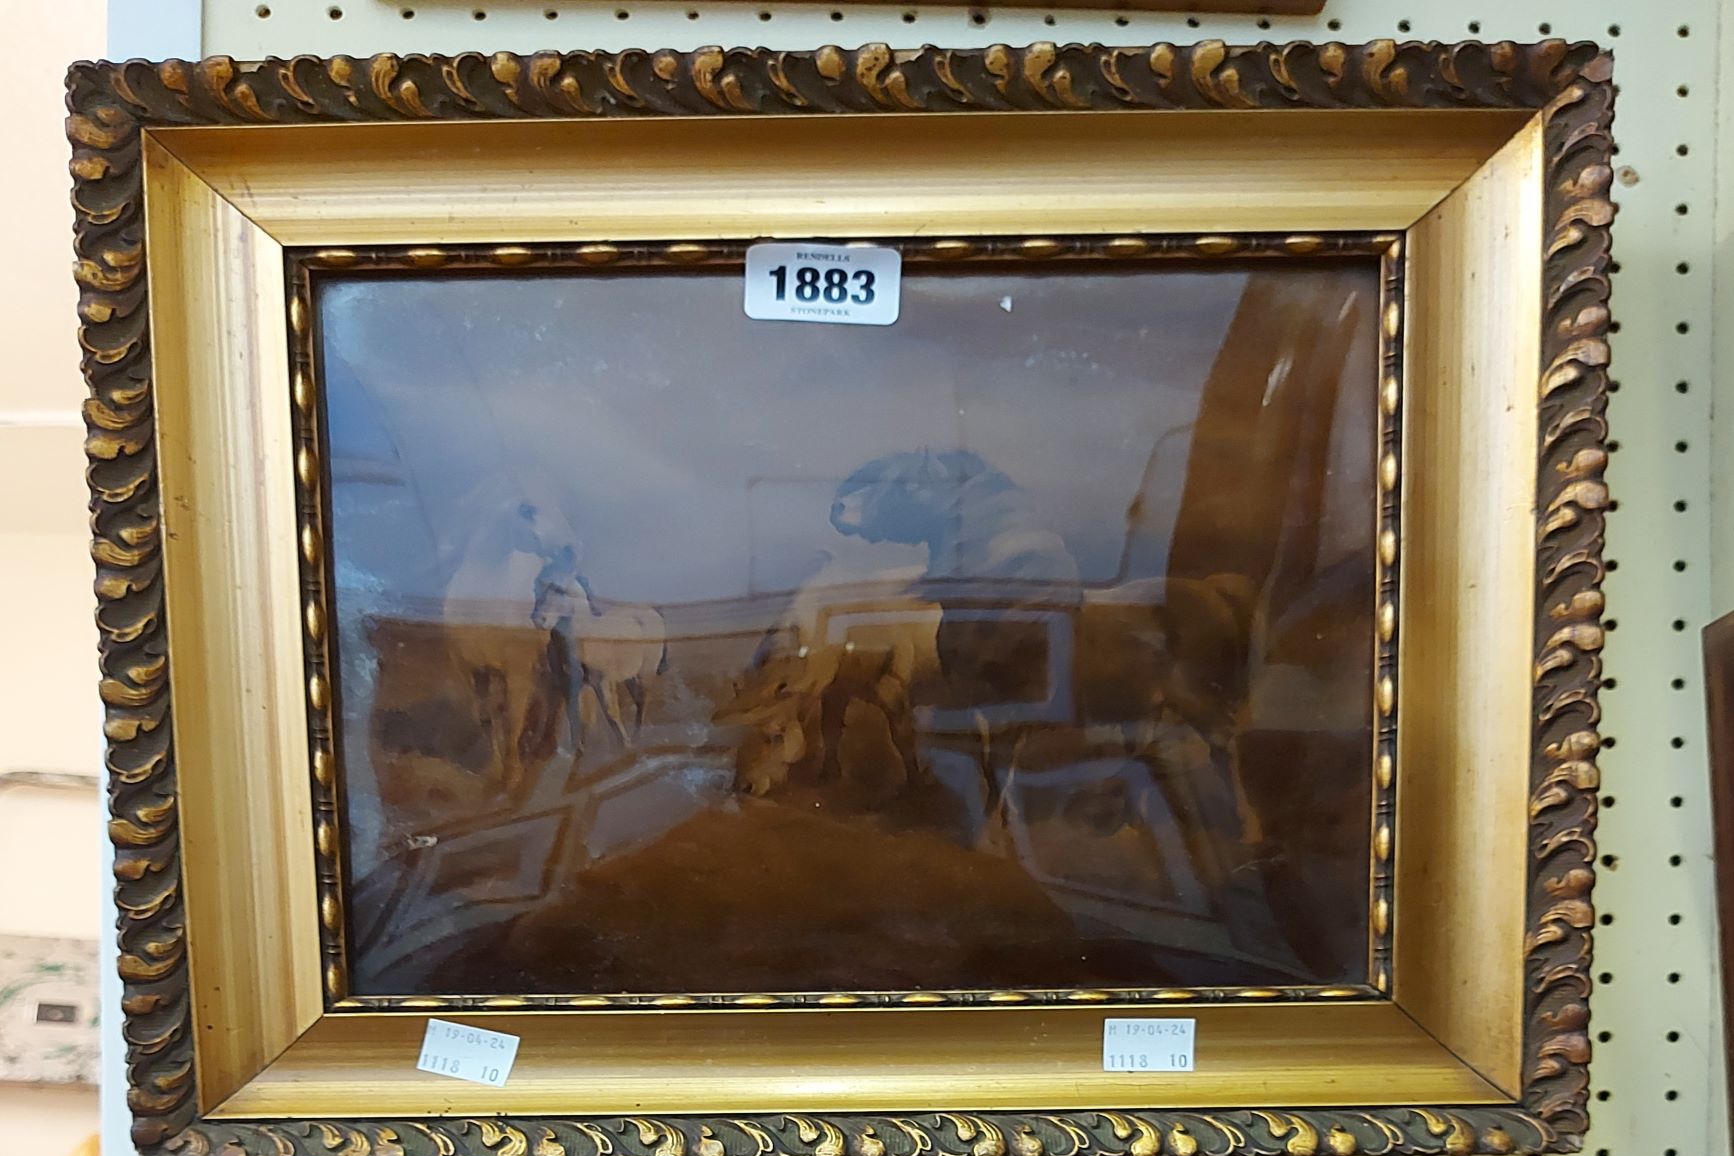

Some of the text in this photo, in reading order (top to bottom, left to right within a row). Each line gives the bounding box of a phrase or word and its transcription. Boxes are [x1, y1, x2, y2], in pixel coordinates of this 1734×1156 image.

[796, 252, 850, 262] RENDELLS
[769, 265, 876, 306] 1883
[790, 307, 851, 317] STONEPARK
[422, 1054, 499, 1082] 1118 10
[1109, 1053, 1188, 1068] 1118 10
